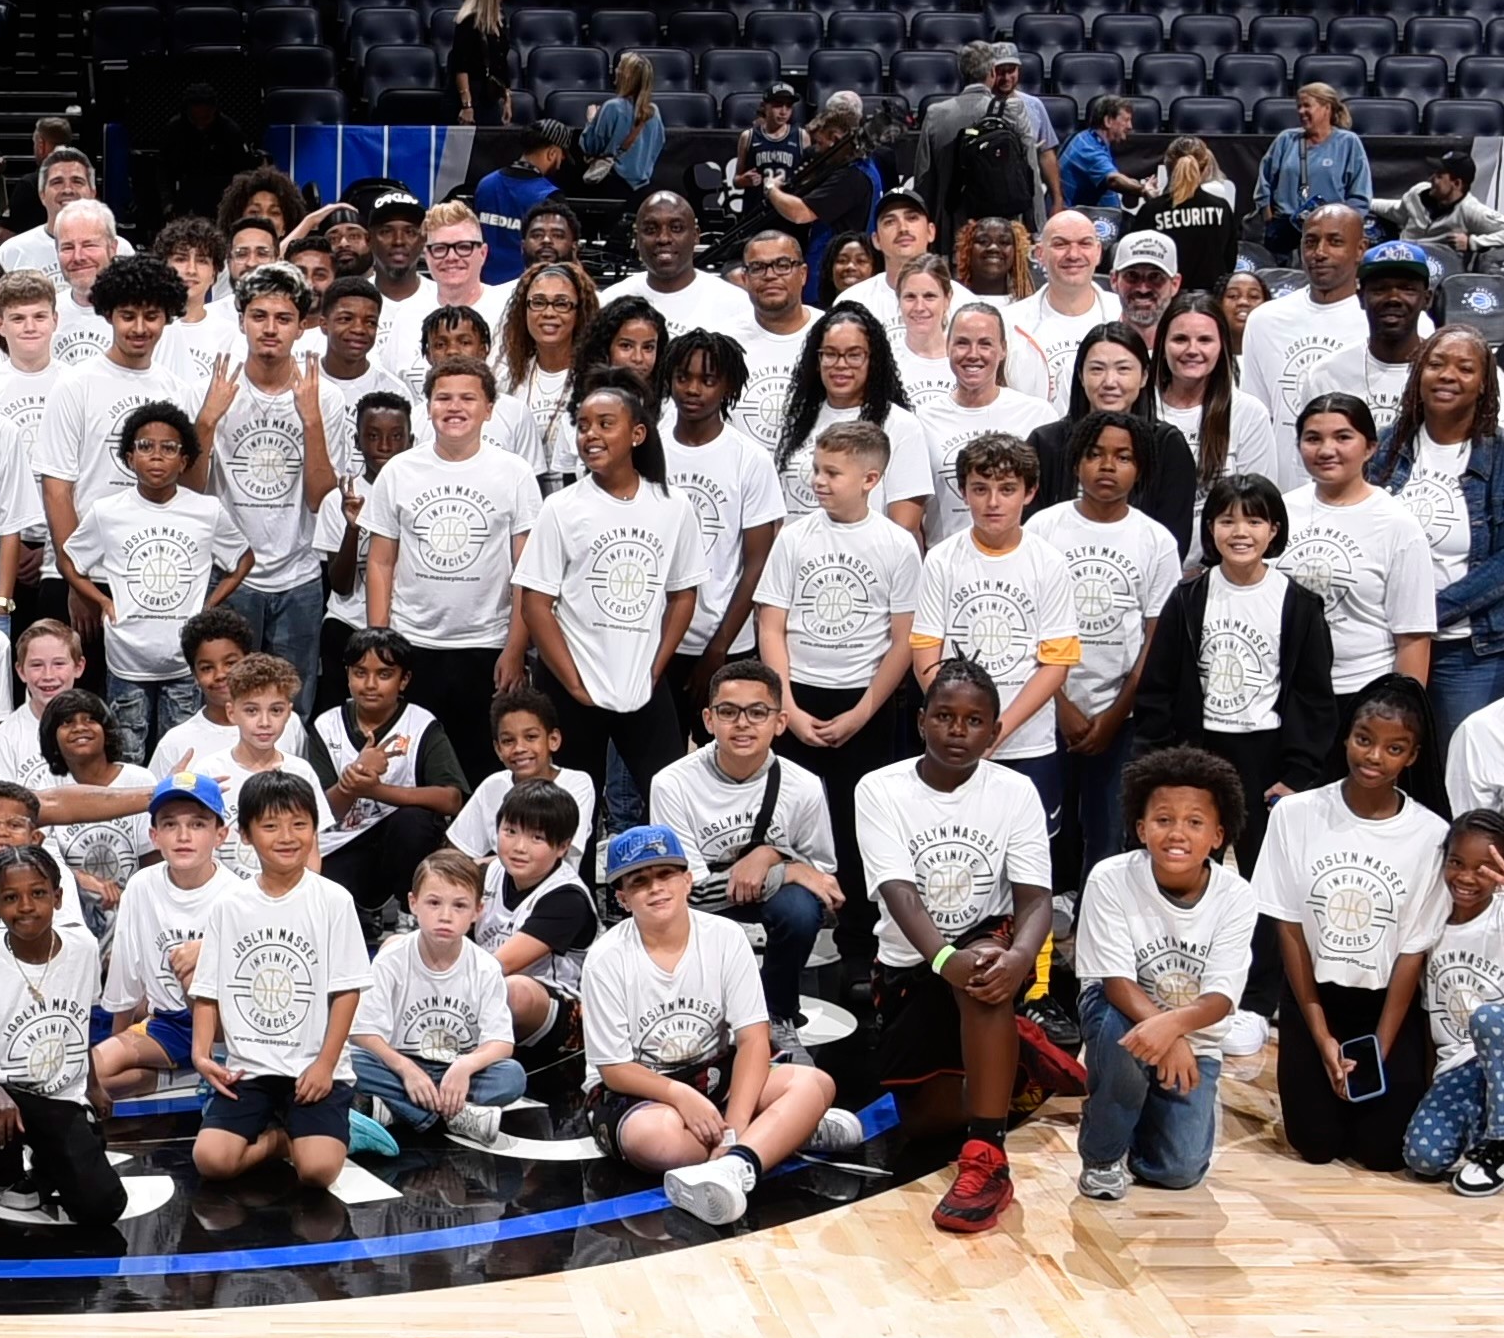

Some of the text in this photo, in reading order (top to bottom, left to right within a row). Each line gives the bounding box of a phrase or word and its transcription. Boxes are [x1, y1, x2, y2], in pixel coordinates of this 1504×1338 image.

[479, 212, 522, 231] MEDIA
[1155, 207, 1224, 231] SECURITY
[247, 436, 290, 453] INFINITE
[245, 480, 286, 495] LEGACIES
[412, 487, 496, 514] JOSLYN MASSEY
[427, 505, 473, 521] INFINITE
[122, 528, 198, 555] JOSLYN MASSEY
[592, 528, 663, 559] JOSLYN MASSEY
[138, 546, 181, 561] INFINITE
[426, 548, 470, 566] LEGACIES
[606, 549, 649, 567] INFINITE
[798, 553, 877, 585] JOSLYN MASSEY
[813, 574, 856, 591] INFINITE
[138, 591, 181, 607] LEGACIES
[604, 597, 647, 615] LEGACIES
[953, 580, 1034, 615] JOSLYN MASSEY
[966, 601, 1013, 620] INFINITE
[1233, 619, 1273, 657] MASSEY
[1207, 640, 1250, 659] INFINITE
[953, 827, 999, 855] MASSEY
[922, 851, 978, 869] INFINITE
[1312, 852, 1407, 896] JOSLYN MASSEY
[1326, 877, 1382, 900] INFINITE
[1320, 928, 1370, 947] LEGACIES
[234, 929, 318, 967] JOSLYN MASSEY
[249, 953, 299, 973] INFINITE
[249, 1009, 296, 1028] LEGACIES
